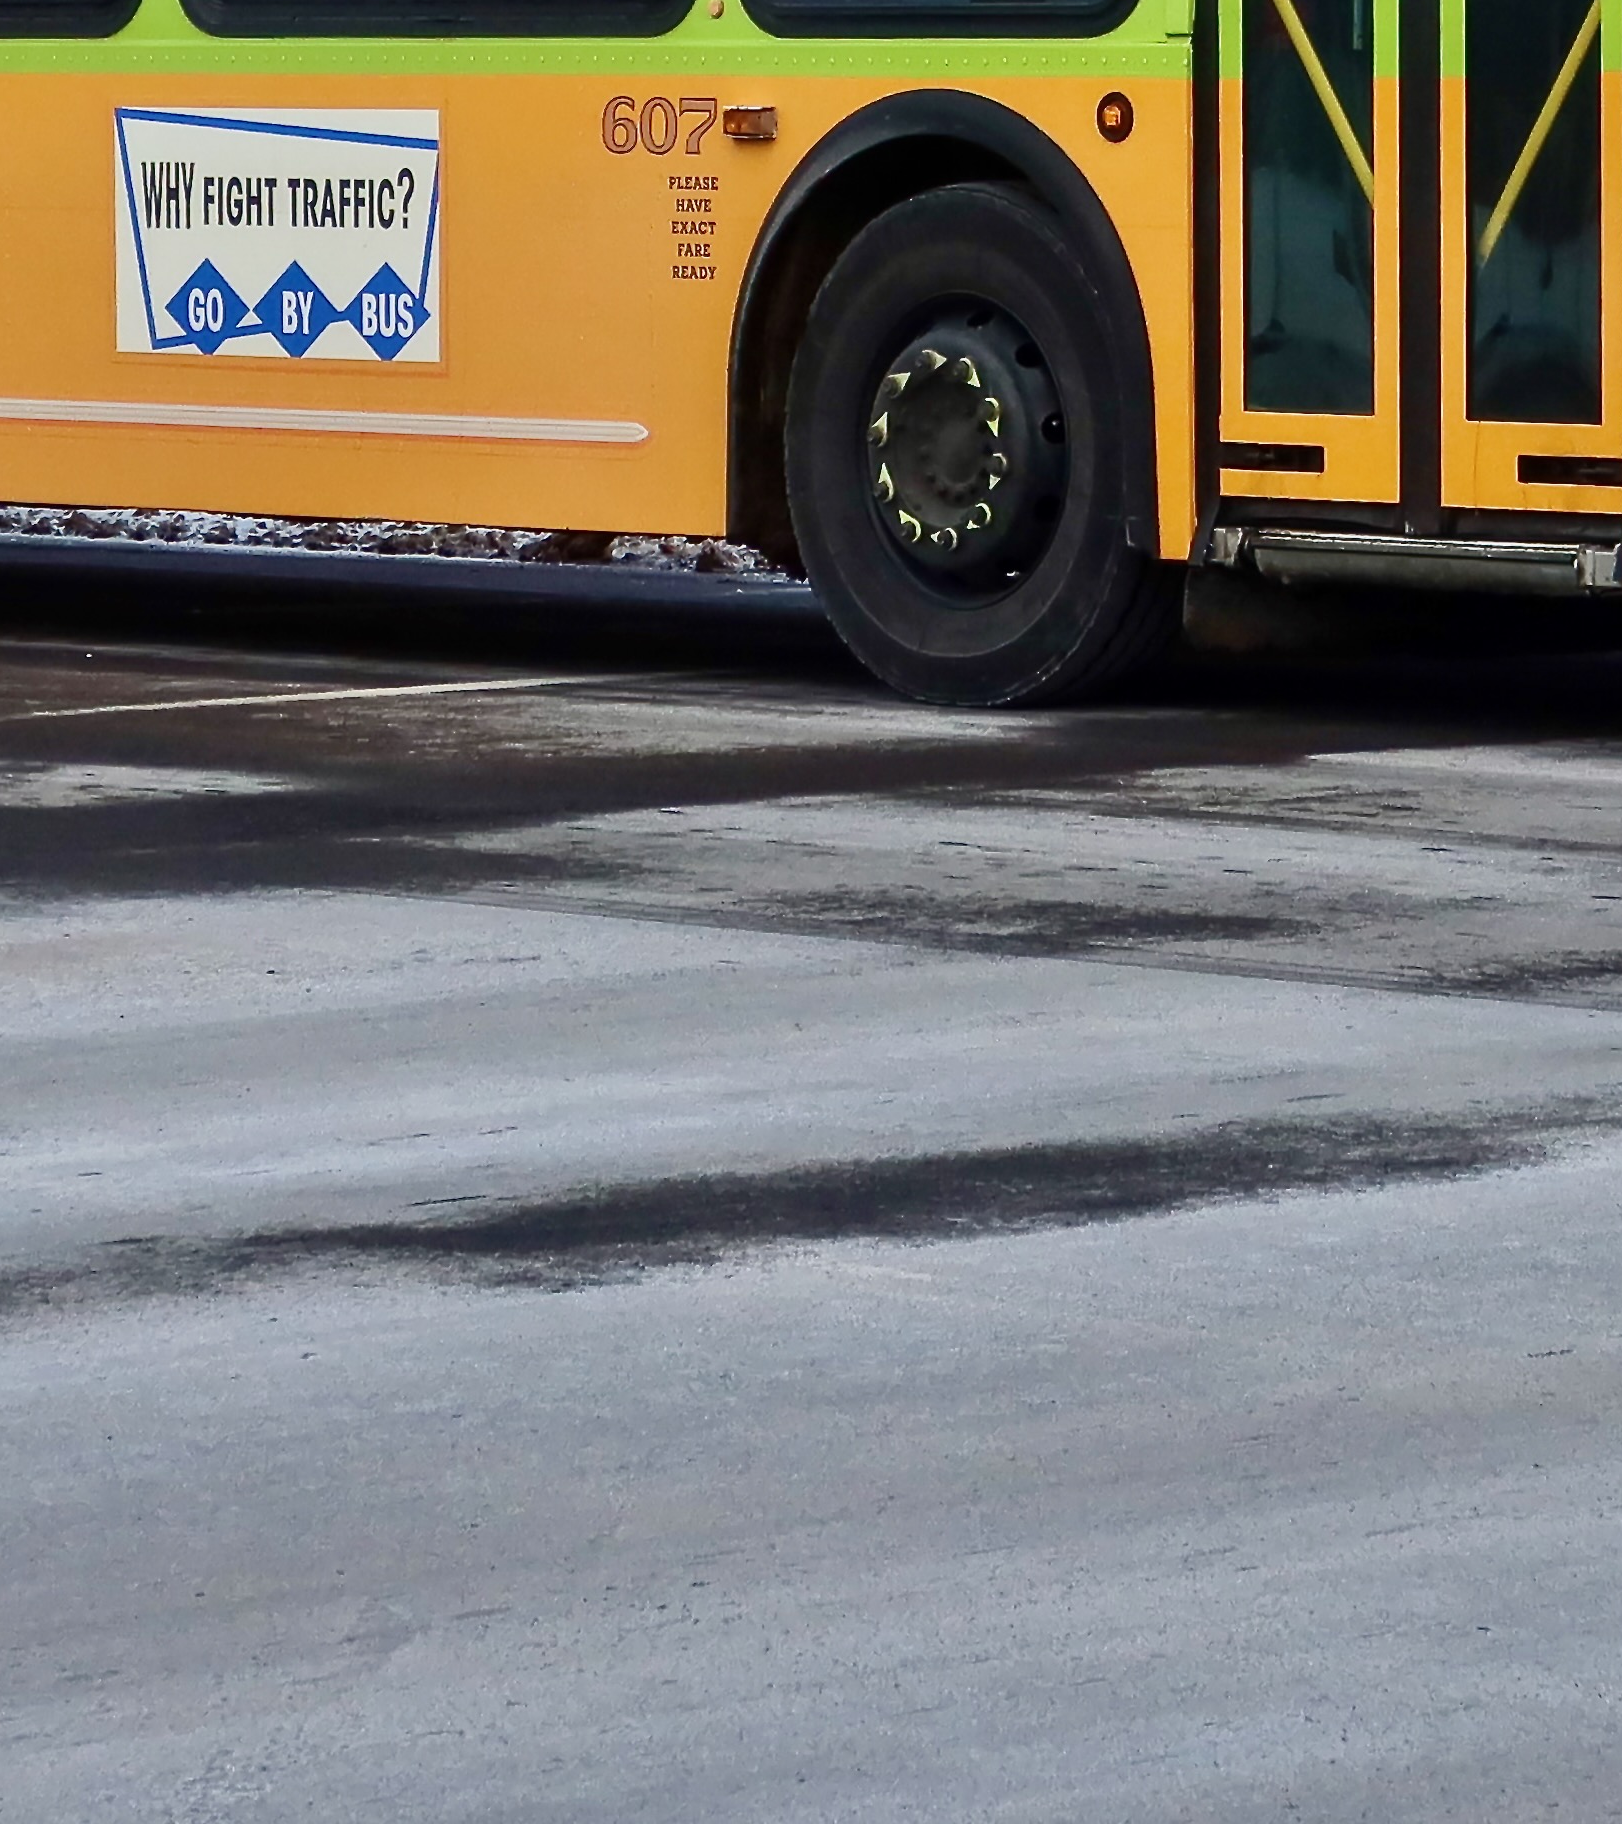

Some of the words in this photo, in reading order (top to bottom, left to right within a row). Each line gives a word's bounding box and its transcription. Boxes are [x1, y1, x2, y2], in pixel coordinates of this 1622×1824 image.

[601, 95, 718, 156] 607
[668, 177, 719, 191] PLEASE
[141, 161, 195, 229] WHY
[203, 177, 277, 226] FIGHT
[287, 167, 415, 229] TRAFFIC?
[675, 199, 712, 213] HAVE
[671, 221, 716, 235] EXACT
[677, 243, 711, 258] FARE
[672, 266, 717, 280] READY
[188, 288, 224, 332] GO
[282, 290, 314, 335] BY
[361, 293, 414, 338] BUS
